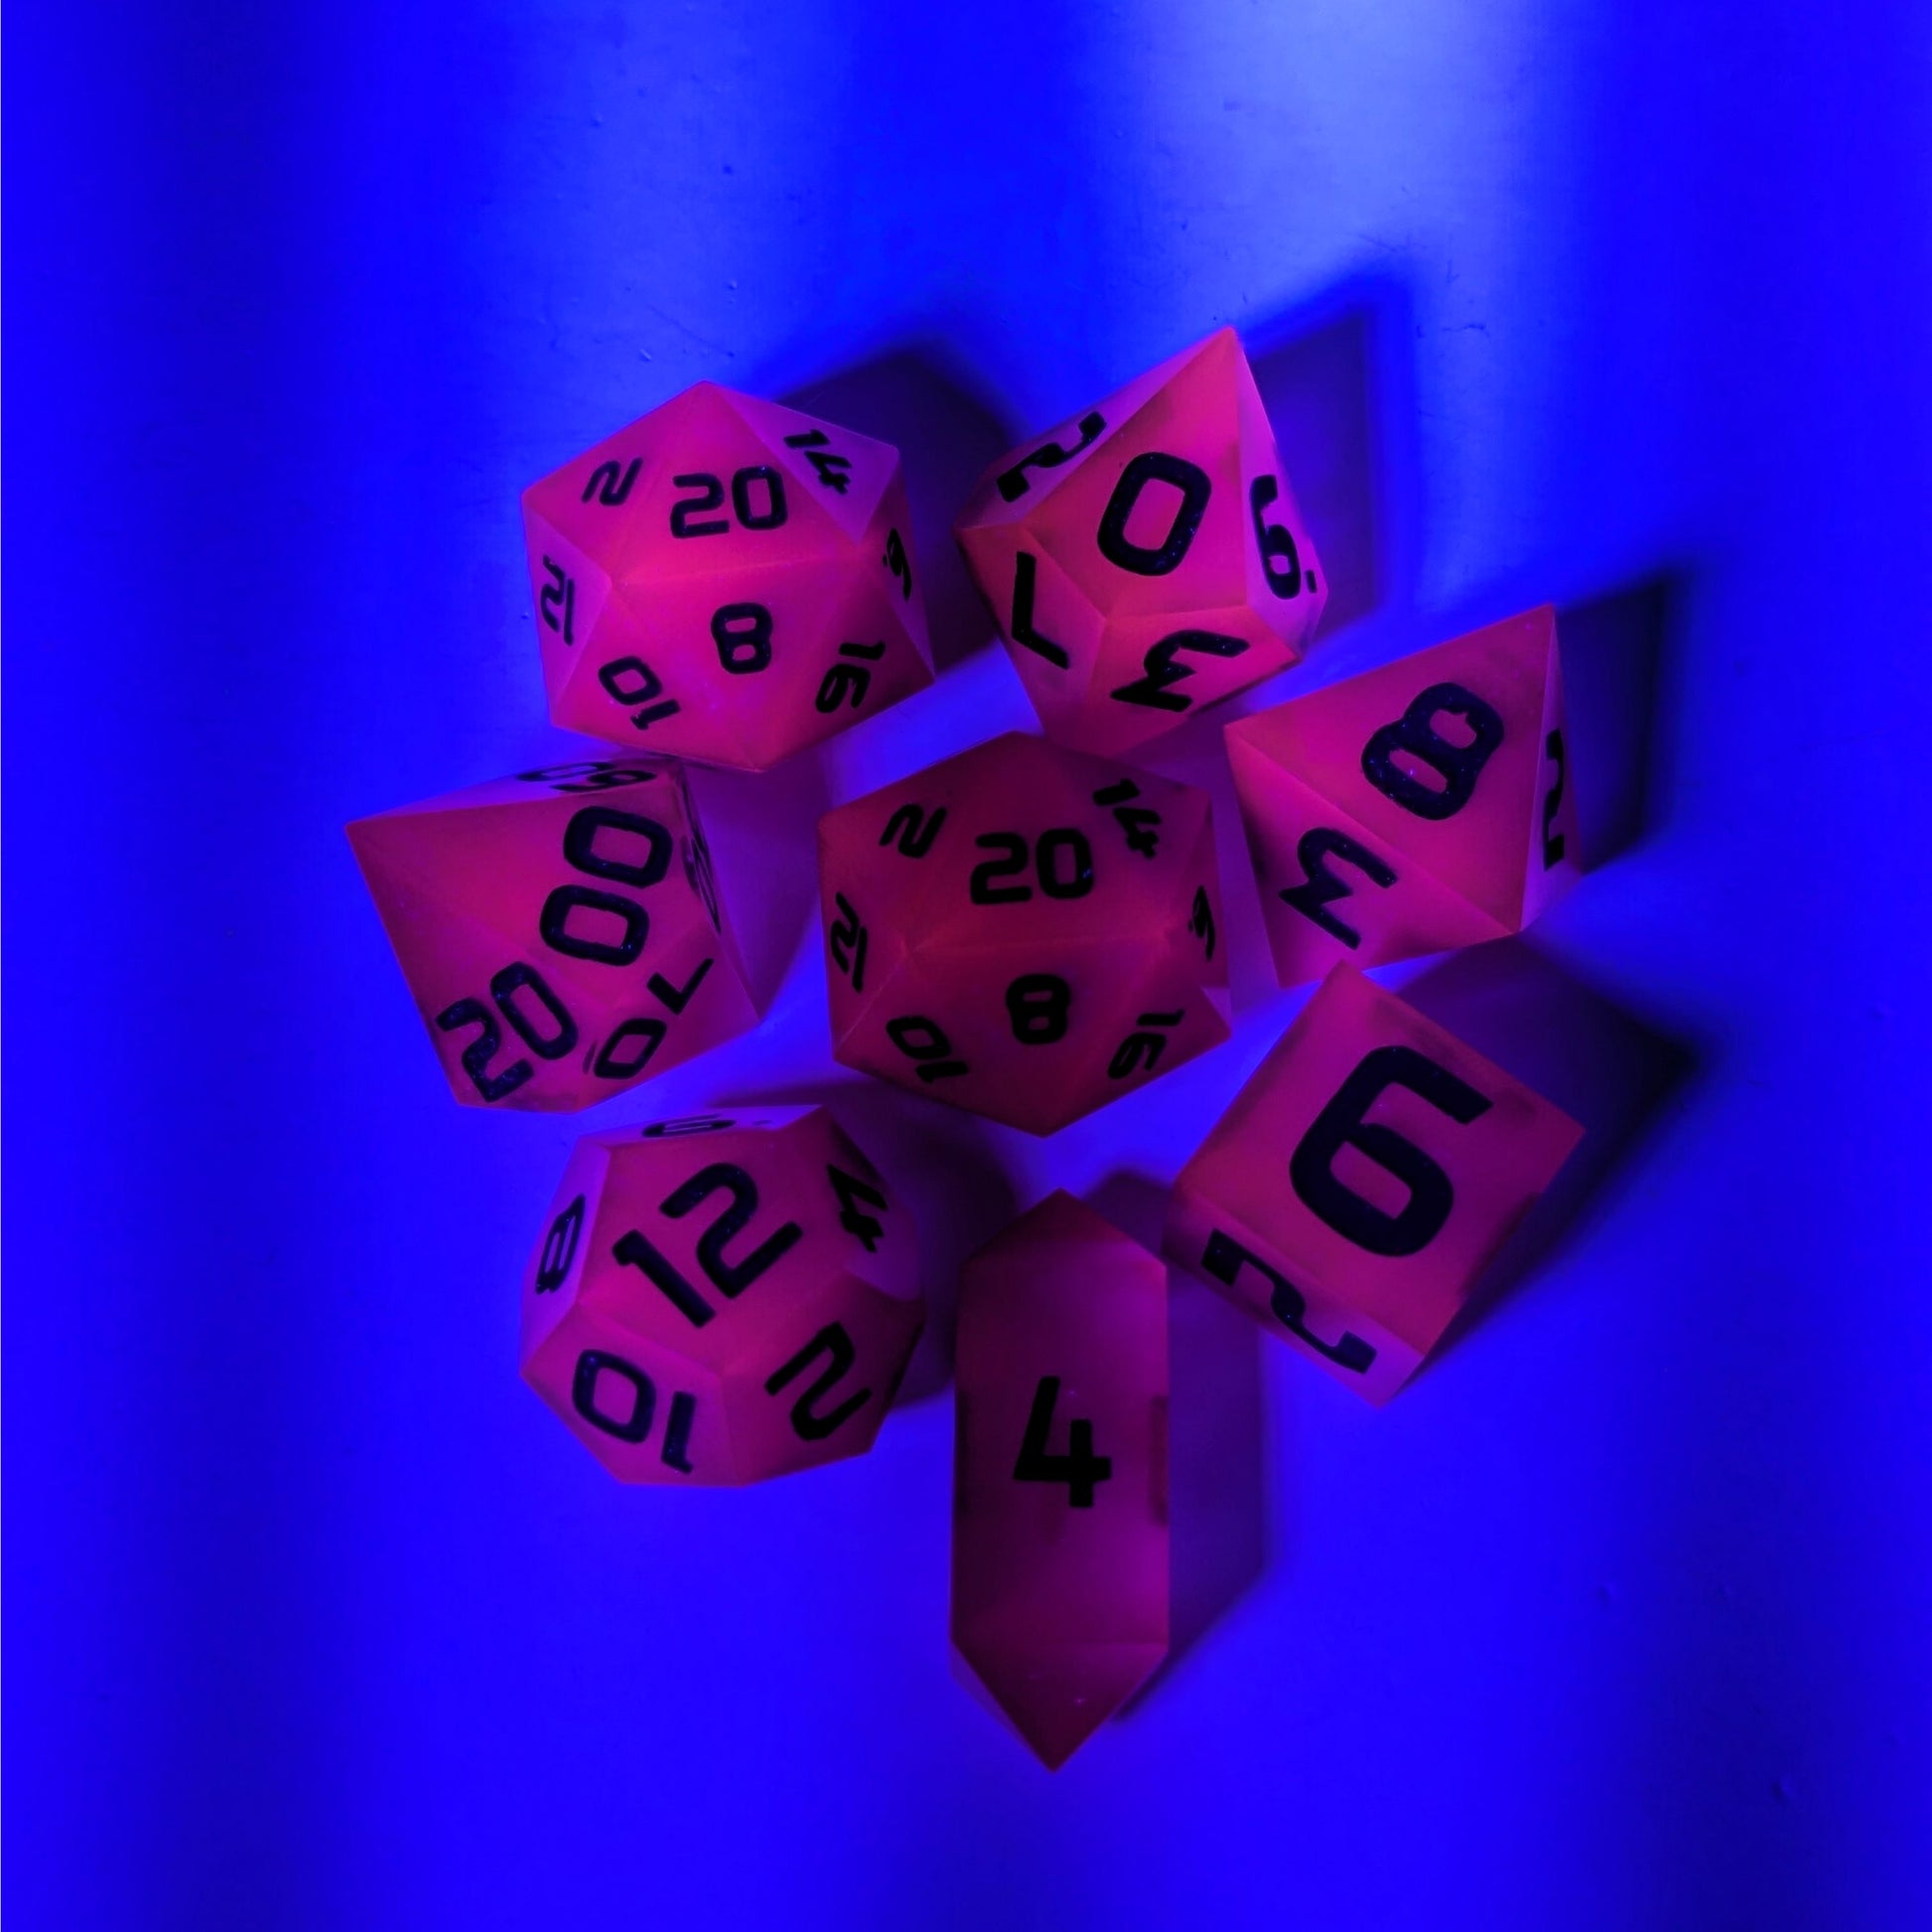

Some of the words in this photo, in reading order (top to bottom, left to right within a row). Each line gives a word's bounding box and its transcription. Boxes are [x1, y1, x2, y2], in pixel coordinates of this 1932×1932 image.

[581, 457, 643, 506] 2
[669, 466, 788, 539] 20
[783, 429, 853, 494] 14
[1096, 451, 1212, 577] 0
[710, 602, 773, 675] 8
[1011, 551, 1070, 670] 7
[598, 655, 682, 731] 10
[814, 640, 887, 714] 16
[1110, 628, 1251, 714] 3
[1361, 682, 1505, 821] 8
[880, 803, 948, 859] 2
[1092, 778, 1162, 859] 14
[539, 805, 674, 967] 00
[970, 827, 1094, 905] 20
[1278, 826, 1399, 950] 3
[435, 960, 579, 1103] 20
[886, 1016, 969, 1084] 10
[1005, 973, 1072, 1045] 8
[1108, 1009, 1185, 1080] 16
[1288, 1044, 1494, 1258] 6
[612, 1162, 803, 1328] 12
[826, 1164, 888, 1253] 4
[572, 1349, 695, 1474] 10
[764, 1320, 873, 1442] 2
[1013, 1376, 1112, 1508] 4
